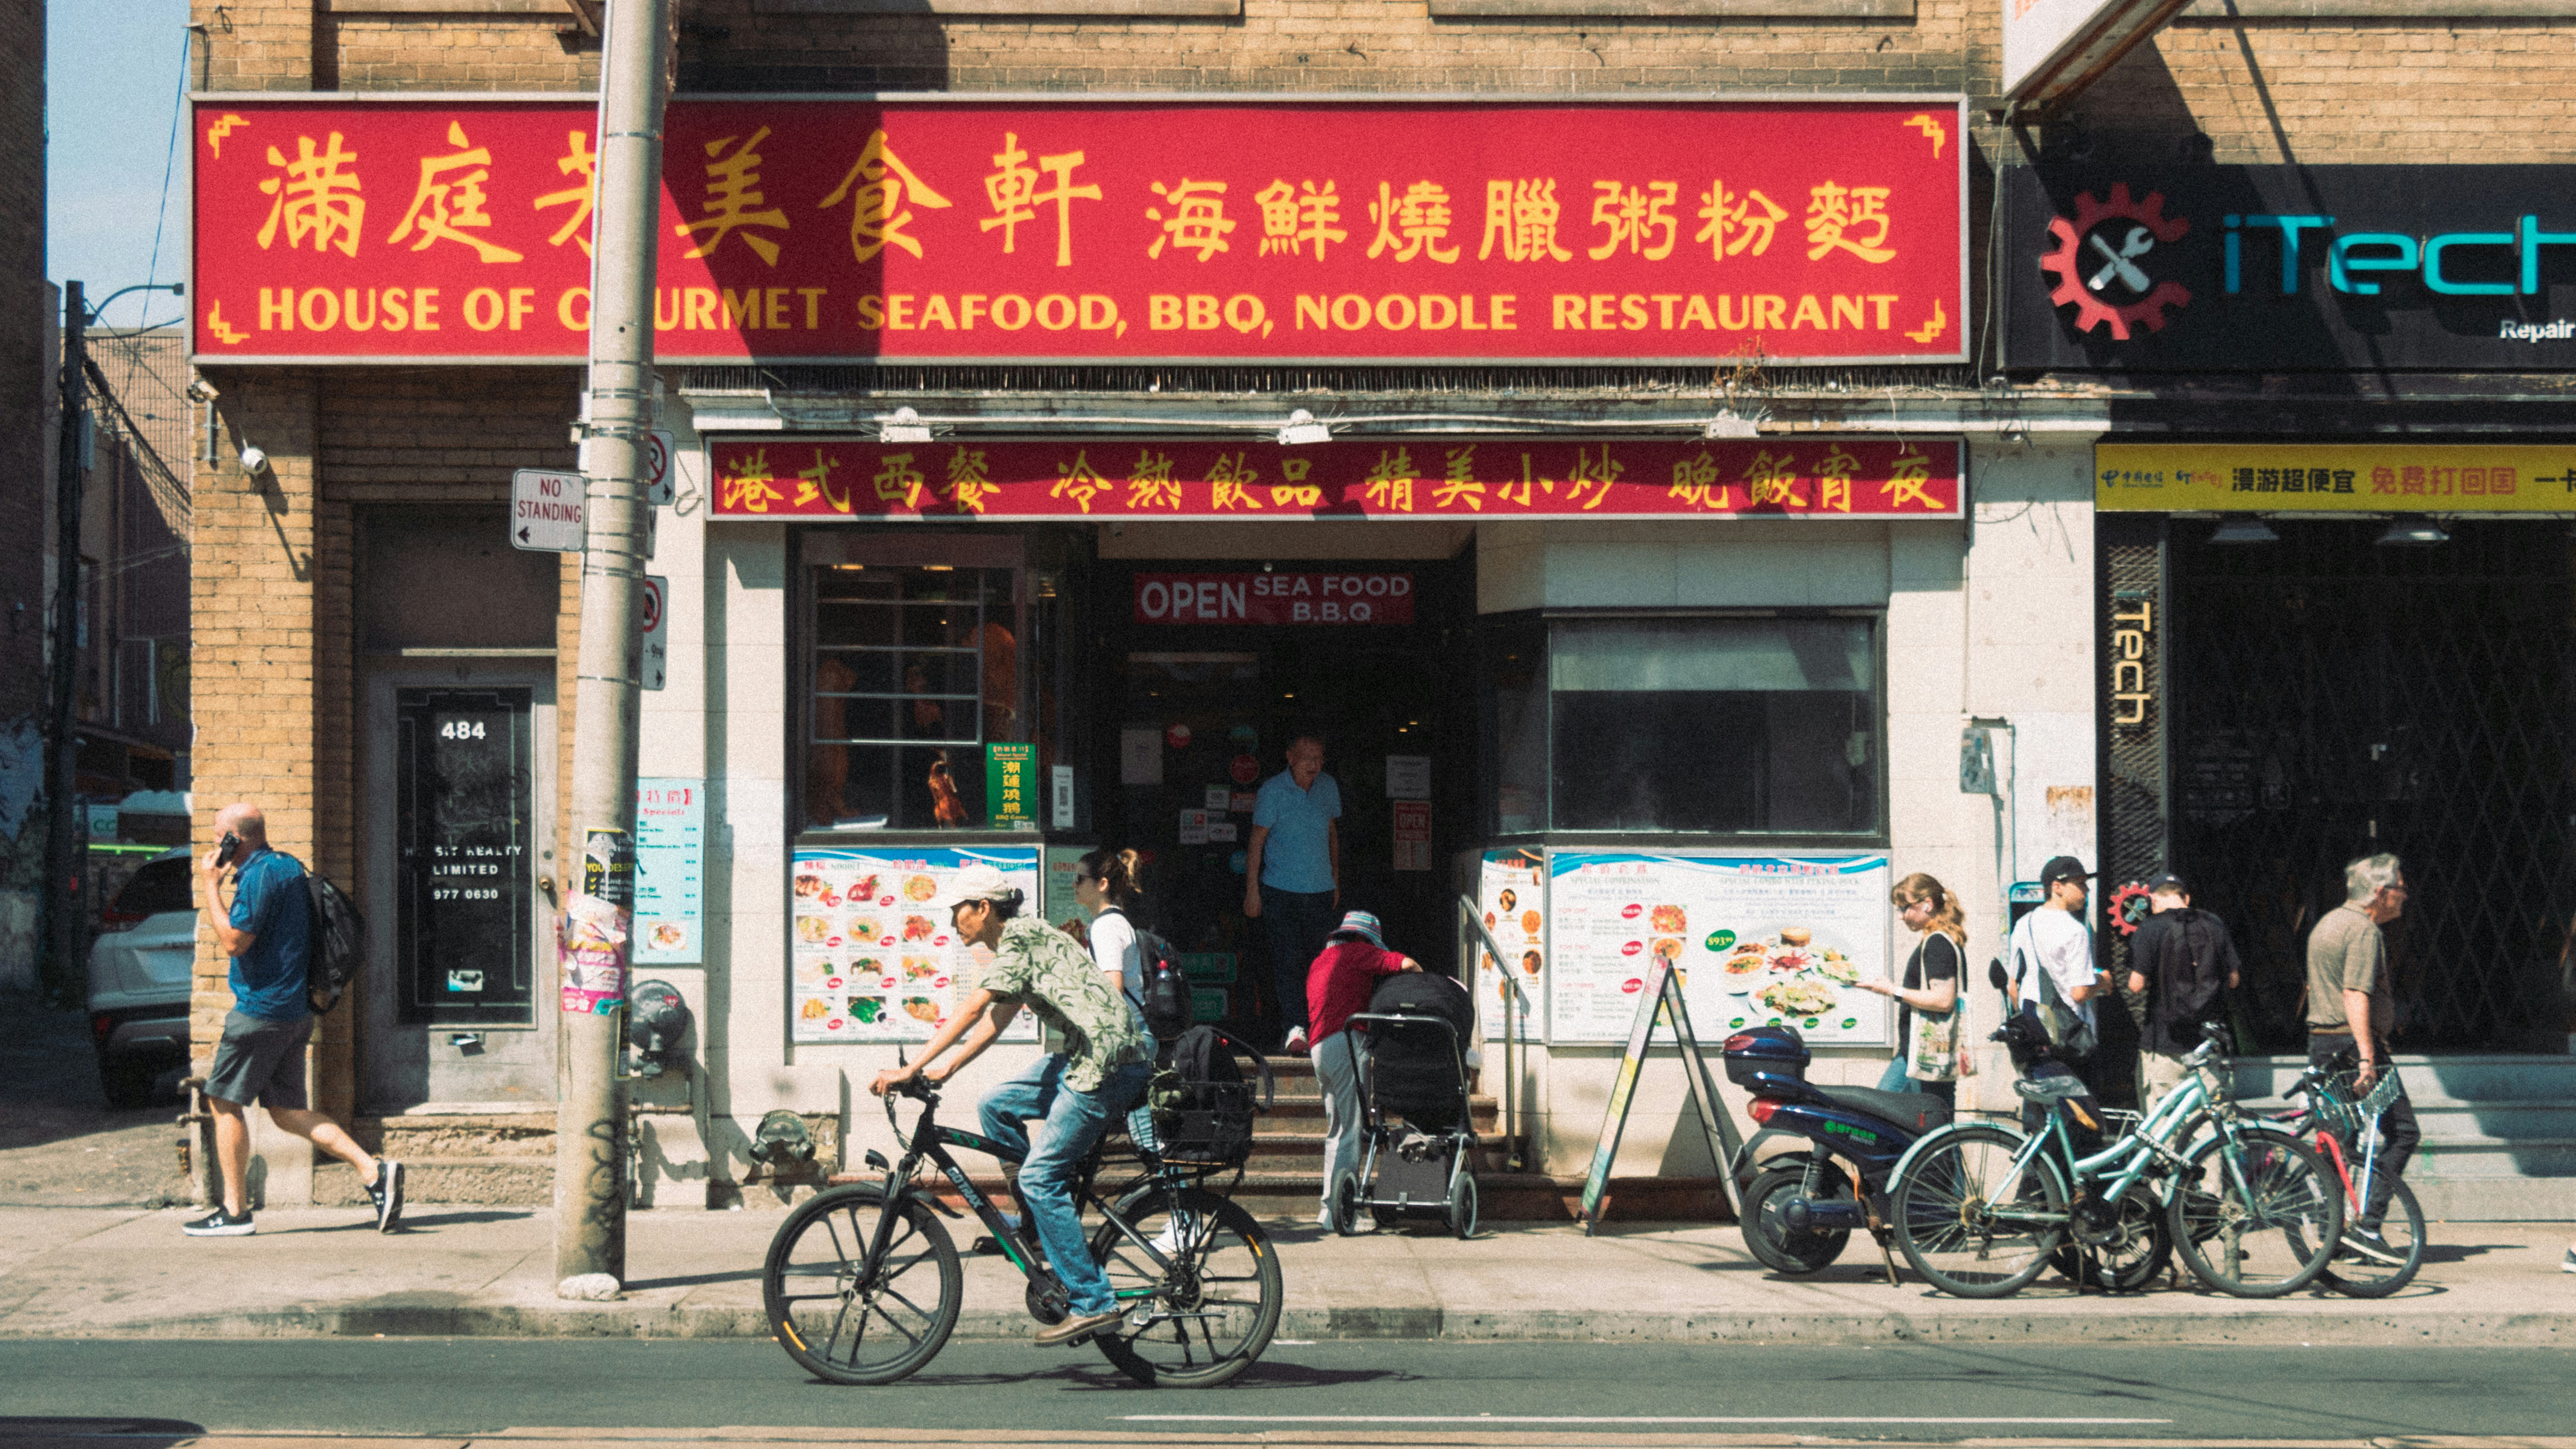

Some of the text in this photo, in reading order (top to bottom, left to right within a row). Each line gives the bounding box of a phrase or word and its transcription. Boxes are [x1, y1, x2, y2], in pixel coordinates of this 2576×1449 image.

[259, 287, 1899, 340] HOUSE OF GURMET SEAFOOD, BBQ, NOODLE RESTAURANT
[2500, 318, 2576, 343] Repair
[540, 478, 562, 498] NO
[723, 444, 1945, 514] 港式西餐 冷熱飲品 精美小炒 晚飯宵夜
[2232, 468, 2356, 493] 漫游超便宜
[518, 501, 582, 523] STANDING
[1141, 576, 1410, 618] OPEN SEA FOOD
[1293, 602, 1372, 621] B.B.Q
[440, 721, 486, 740] 484
[1399, 813, 1425, 829] OPEN
[433, 864, 499, 876] LIMITED
[433, 889, 499, 900] 977 0630
